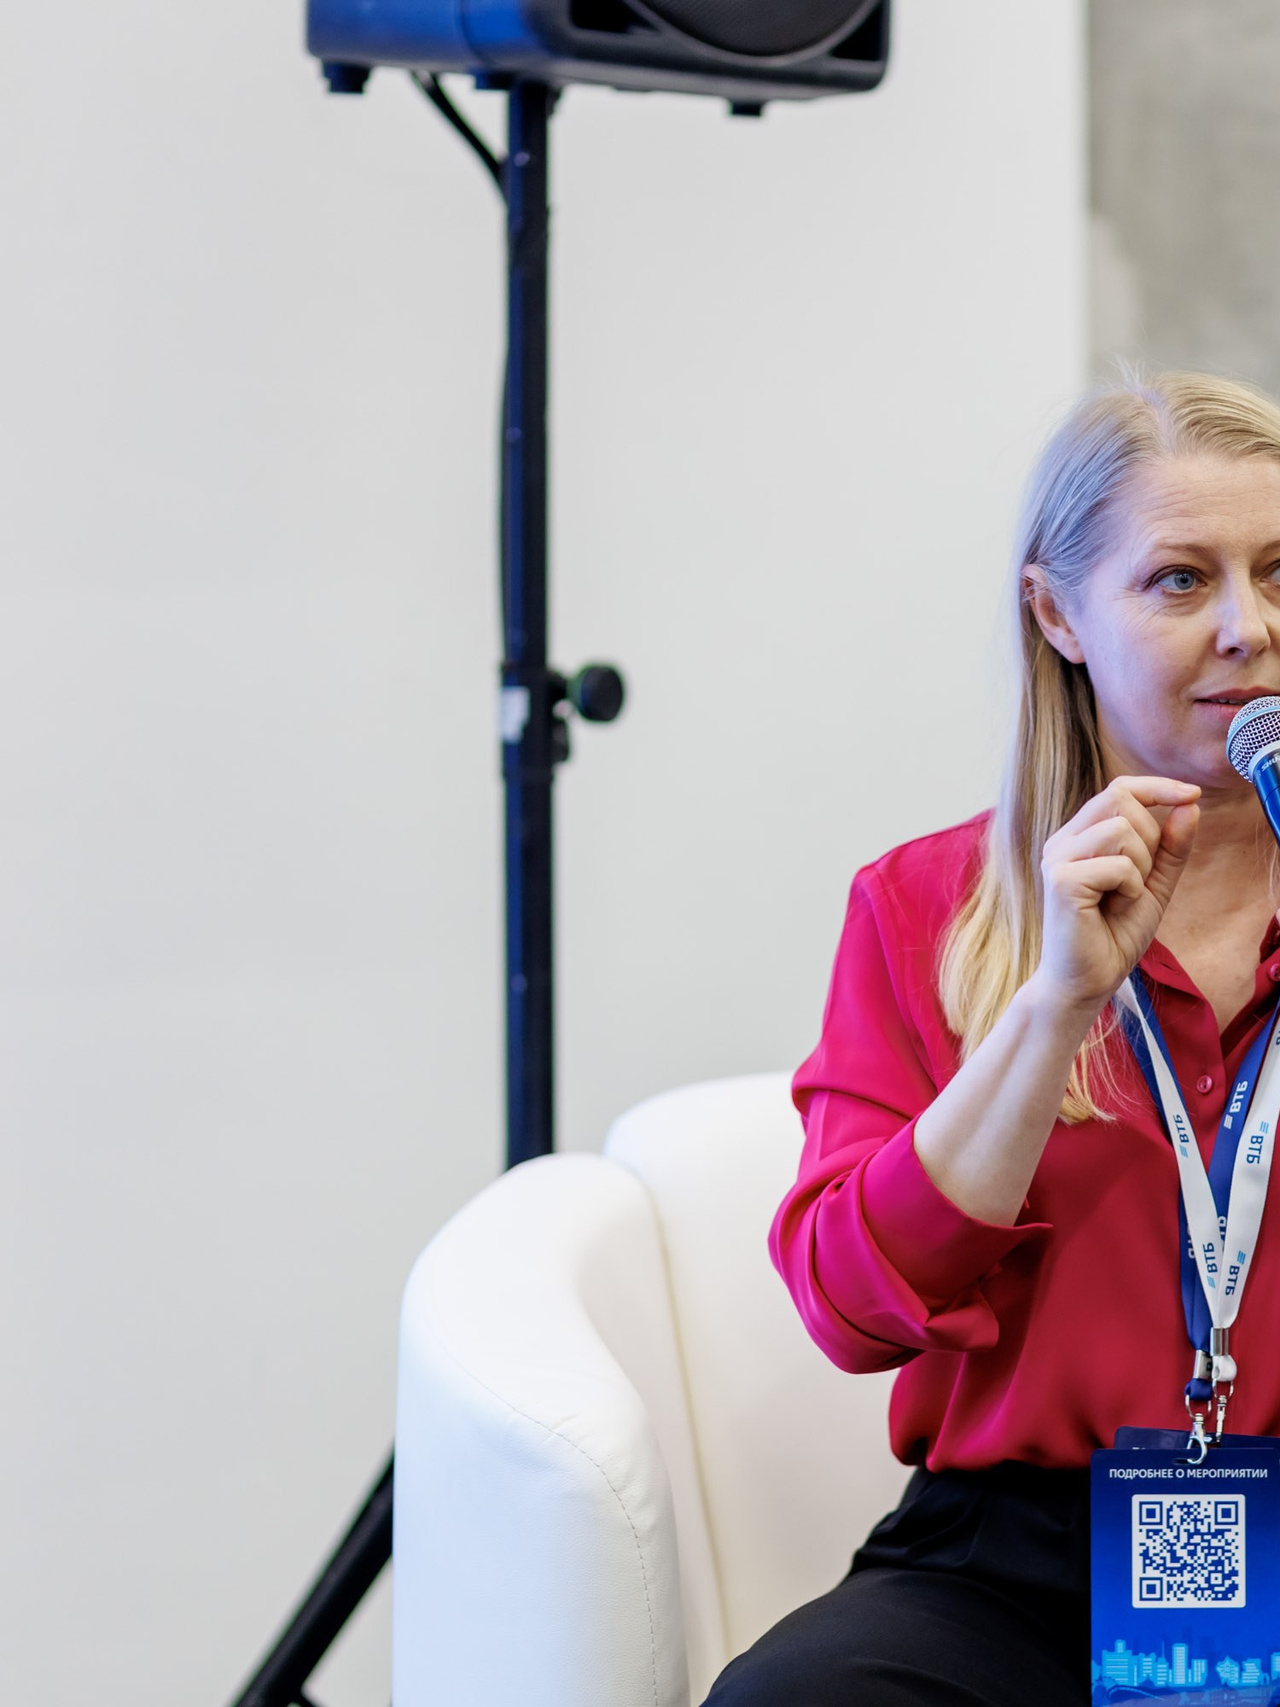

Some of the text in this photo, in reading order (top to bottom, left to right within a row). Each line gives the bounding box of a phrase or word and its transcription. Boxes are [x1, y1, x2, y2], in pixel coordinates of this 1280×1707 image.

[1229, 1080, 1248, 1114] ВТБ
[1173, 1114, 1190, 1143] ВТБ
[1246, 1135, 1264, 1164] ВТБ
[1203, 1242, 1218, 1273] ВТБ
[1225, 1265, 1240, 1295] ВТБ
[1109, 1468, 1268, 1480] ПОДРОБНЕЕ О МЕРОПРИЯТИИ
